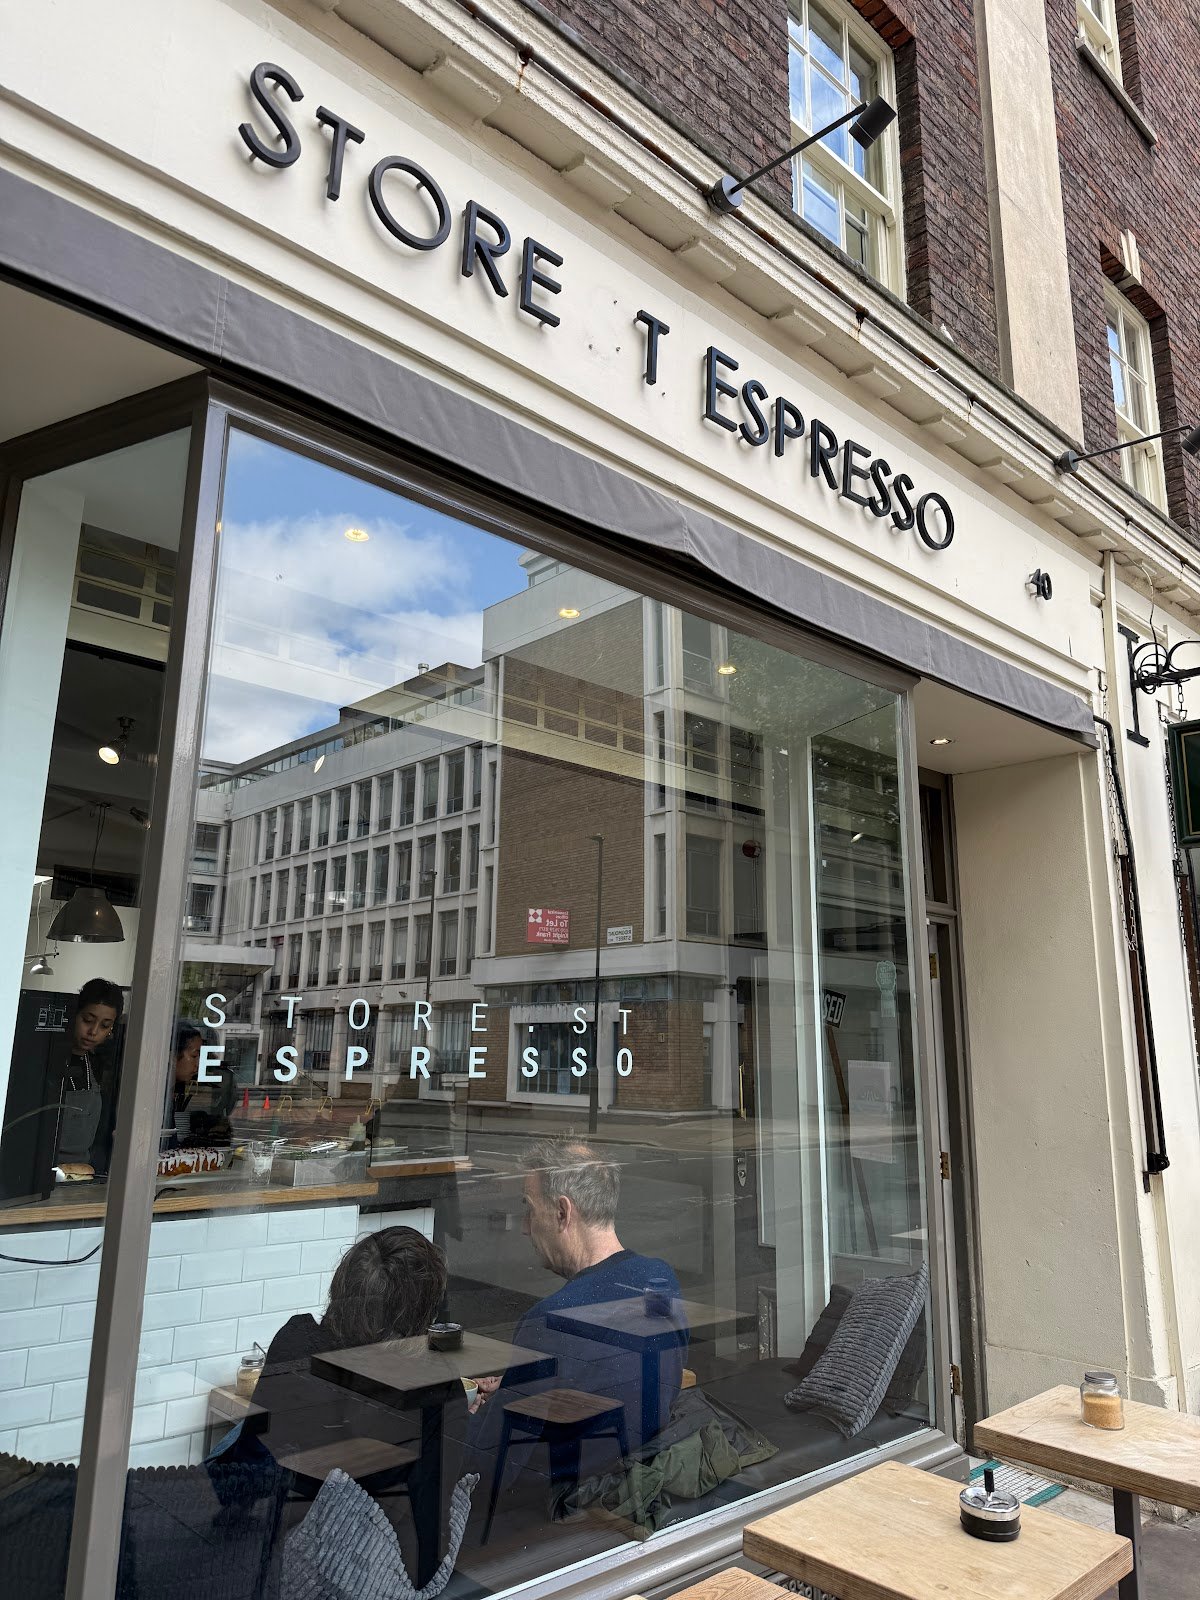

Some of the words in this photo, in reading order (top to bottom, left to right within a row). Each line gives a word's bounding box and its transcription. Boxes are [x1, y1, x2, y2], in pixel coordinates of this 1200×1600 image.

[238, 62, 564, 328] STORE
[705, 345, 955, 551] ESPRESSO
[197, 1045, 634, 1083] ESPRESSO
